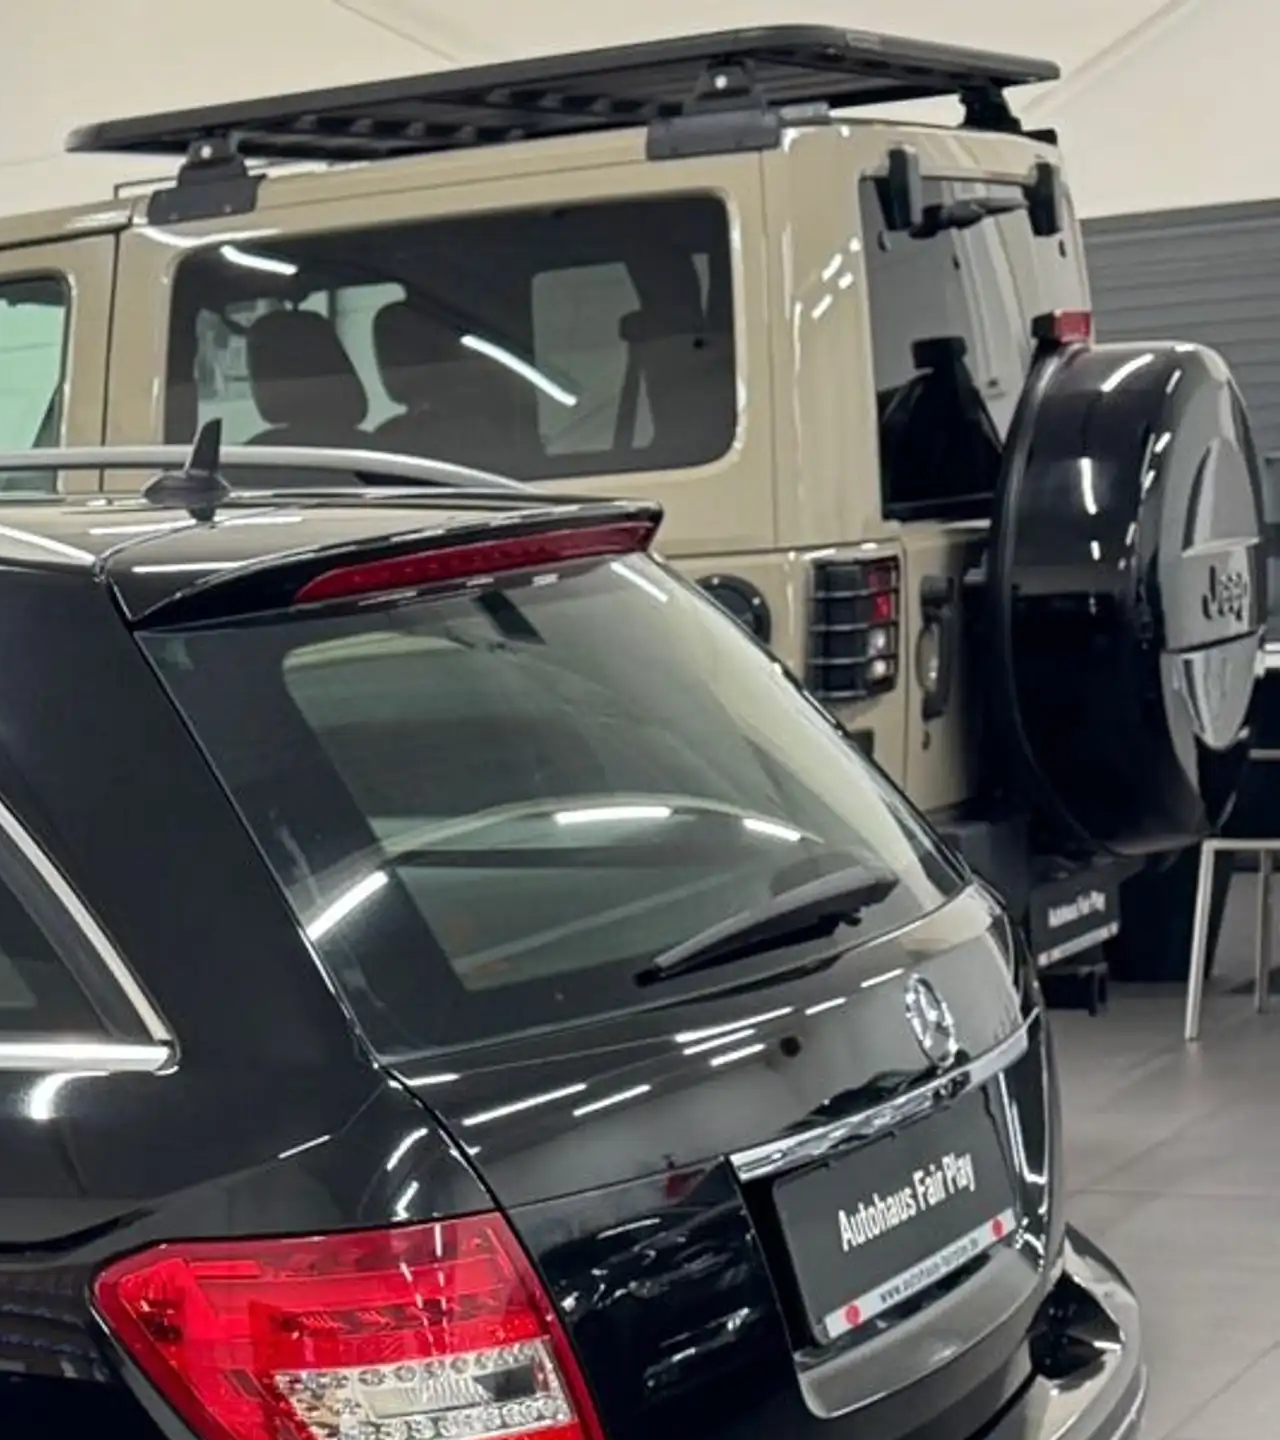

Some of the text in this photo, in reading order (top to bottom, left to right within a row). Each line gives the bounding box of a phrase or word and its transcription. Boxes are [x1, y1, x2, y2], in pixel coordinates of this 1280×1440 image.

[838, 1151, 976, 1252] Autohaus Fair Play
